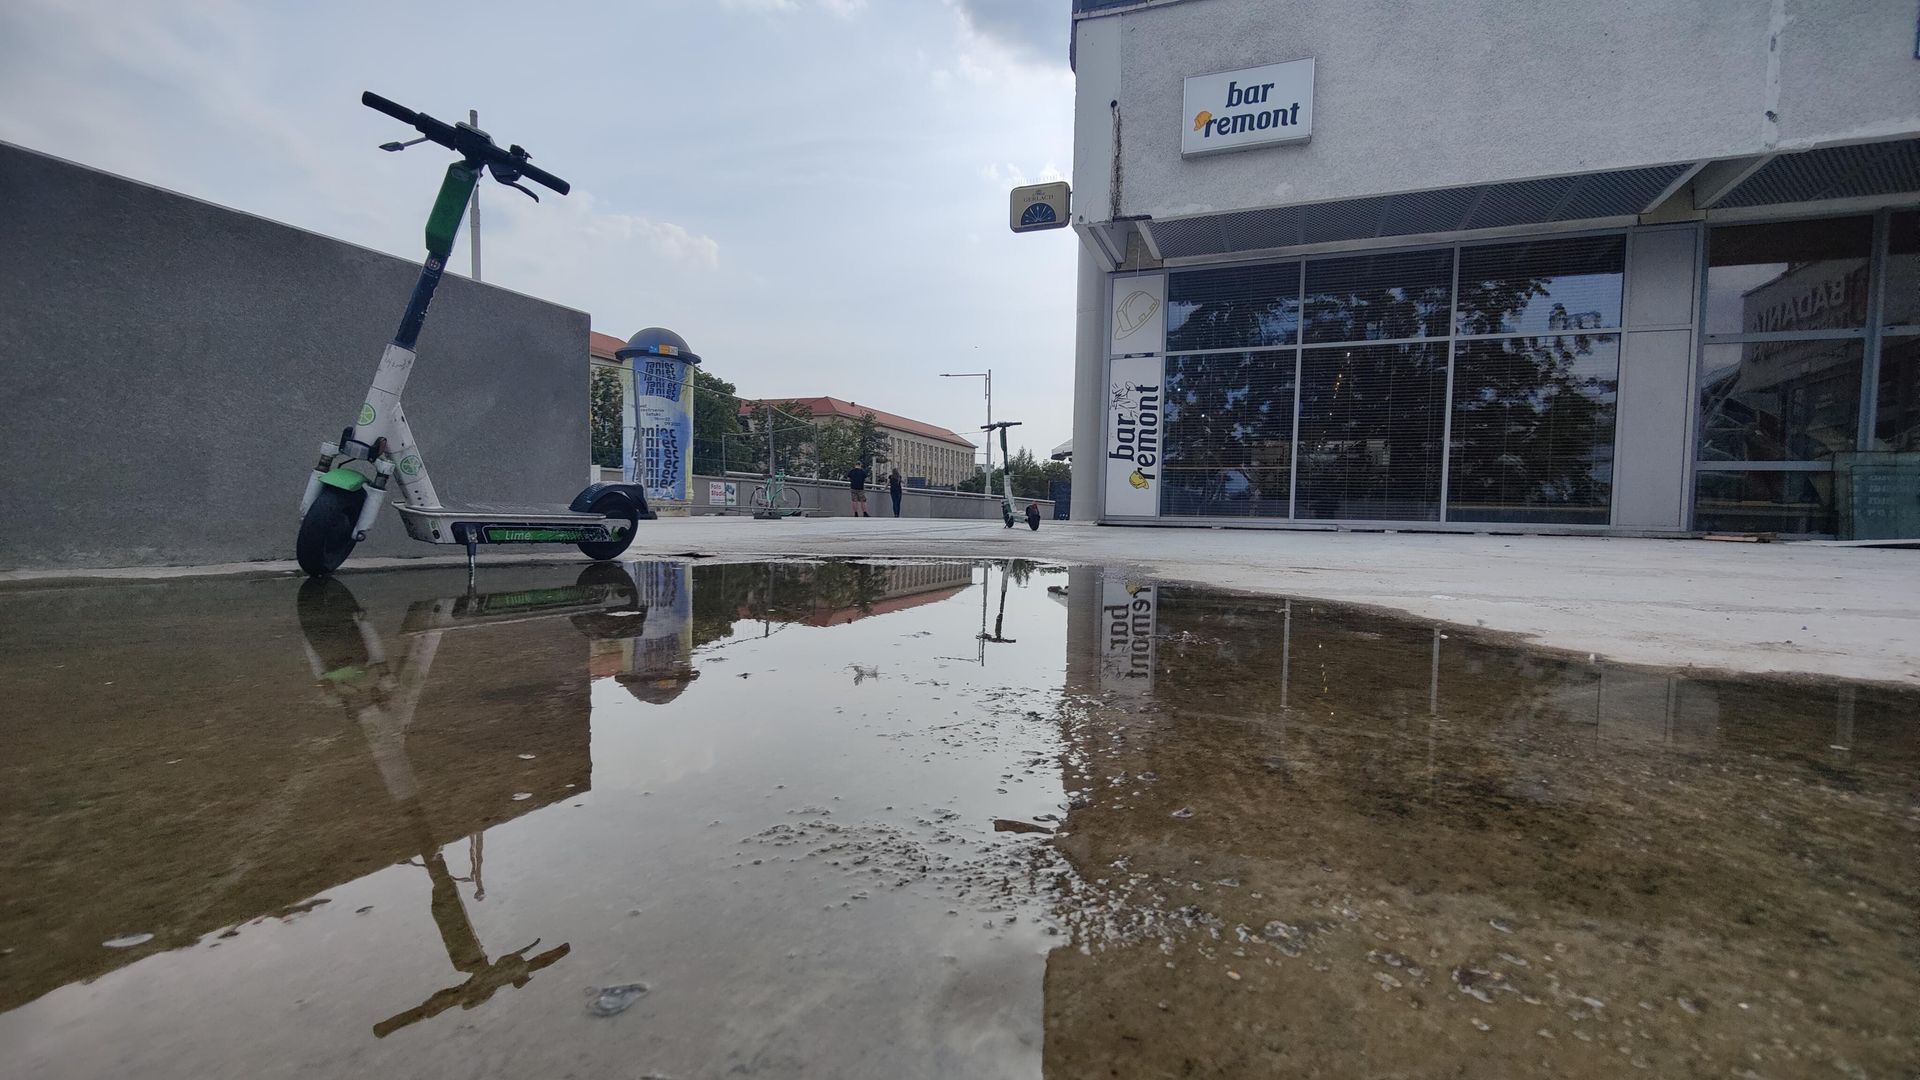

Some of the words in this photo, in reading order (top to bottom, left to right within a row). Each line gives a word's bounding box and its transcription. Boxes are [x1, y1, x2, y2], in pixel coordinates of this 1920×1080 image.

[1225, 81, 1274, 108] bar
[1204, 102, 1300, 138] remont
[645, 361, 674, 370] Taniec
[1109, 413, 1136, 462] bar
[1135, 384, 1159, 480] remont
